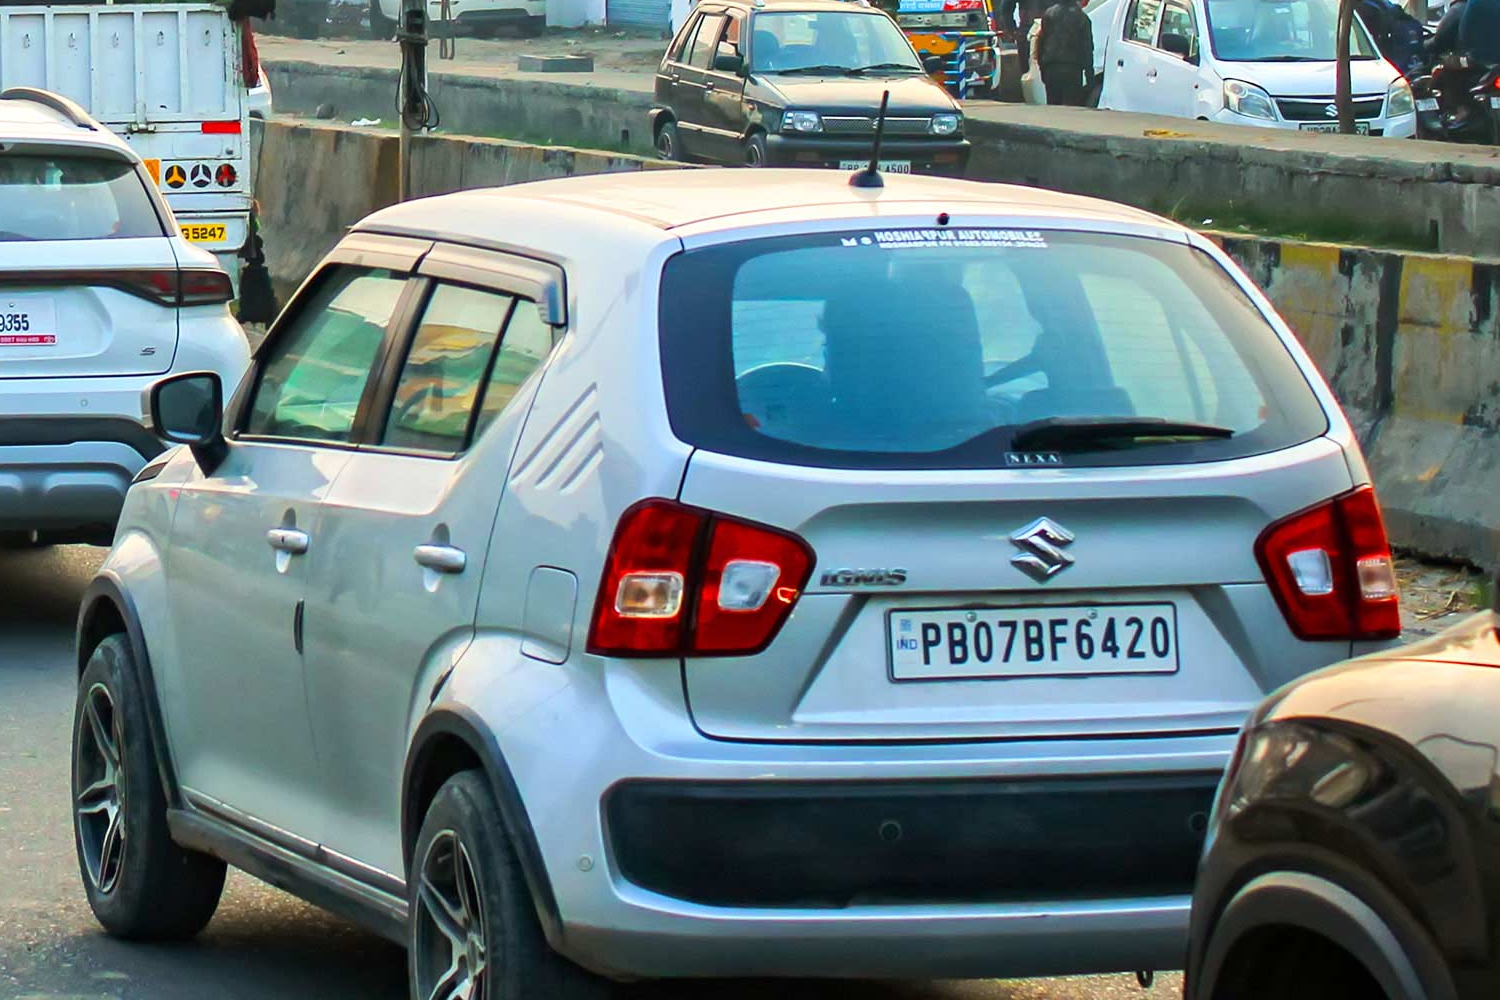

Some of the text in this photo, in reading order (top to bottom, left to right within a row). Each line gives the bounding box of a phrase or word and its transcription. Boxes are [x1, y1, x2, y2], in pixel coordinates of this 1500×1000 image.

[191, 226, 225, 240] 5247
[820, 568, 908, 587] IGNIS
[896, 616, 1171, 666] IND PB07BF6420
